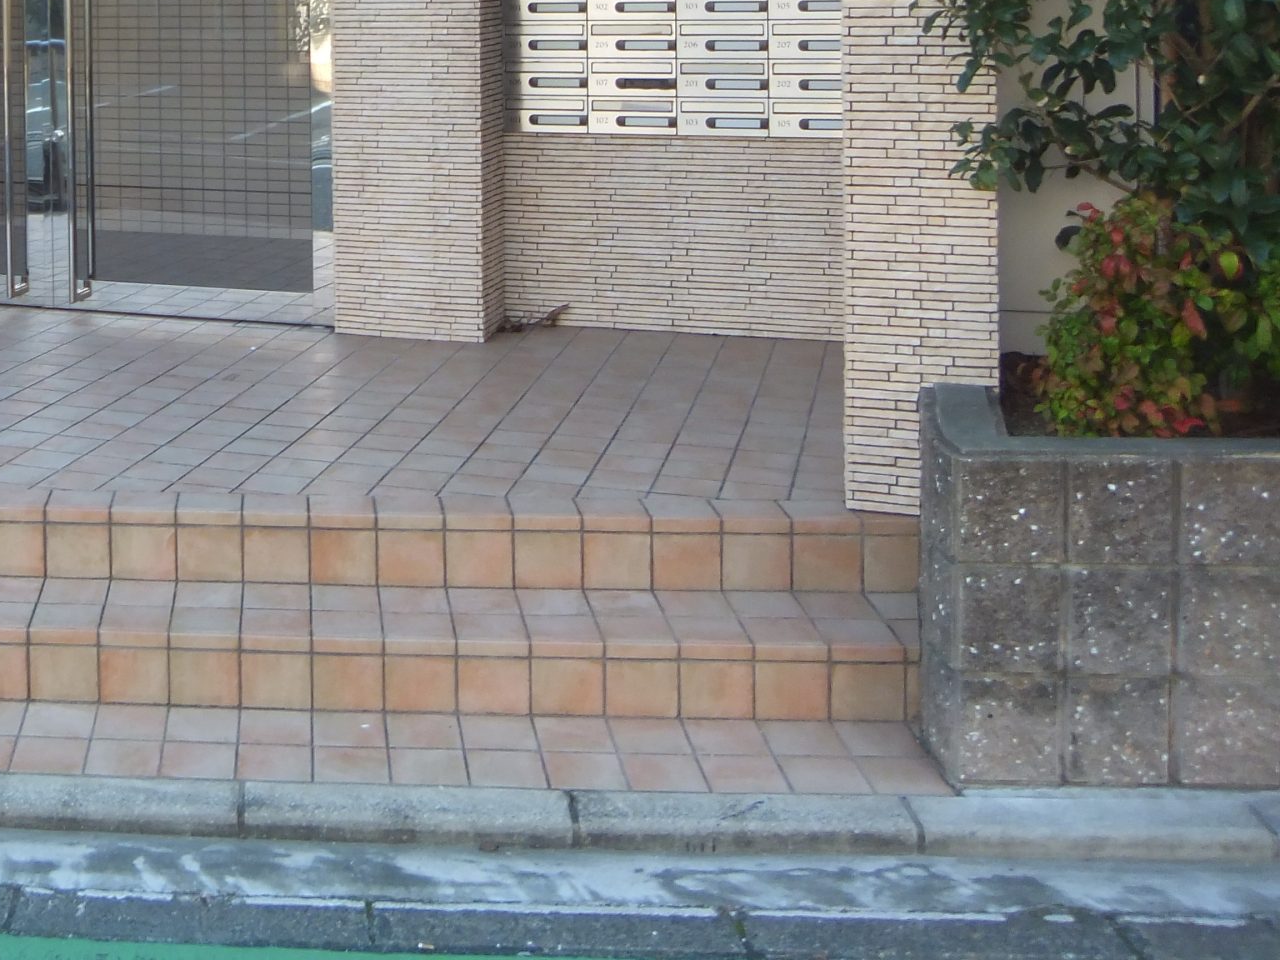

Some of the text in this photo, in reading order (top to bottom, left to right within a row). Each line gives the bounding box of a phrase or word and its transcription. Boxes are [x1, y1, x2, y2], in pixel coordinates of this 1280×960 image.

[683, 40, 699, 49] 206
[776, 40, 792, 49] 207
[596, 78, 609, 87] 107
[684, 79, 698, 88] 201
[776, 79, 792, 88] 202
[596, 116, 609, 125] 102
[685, 117, 698, 126] 103
[777, 119, 792, 128] 105
